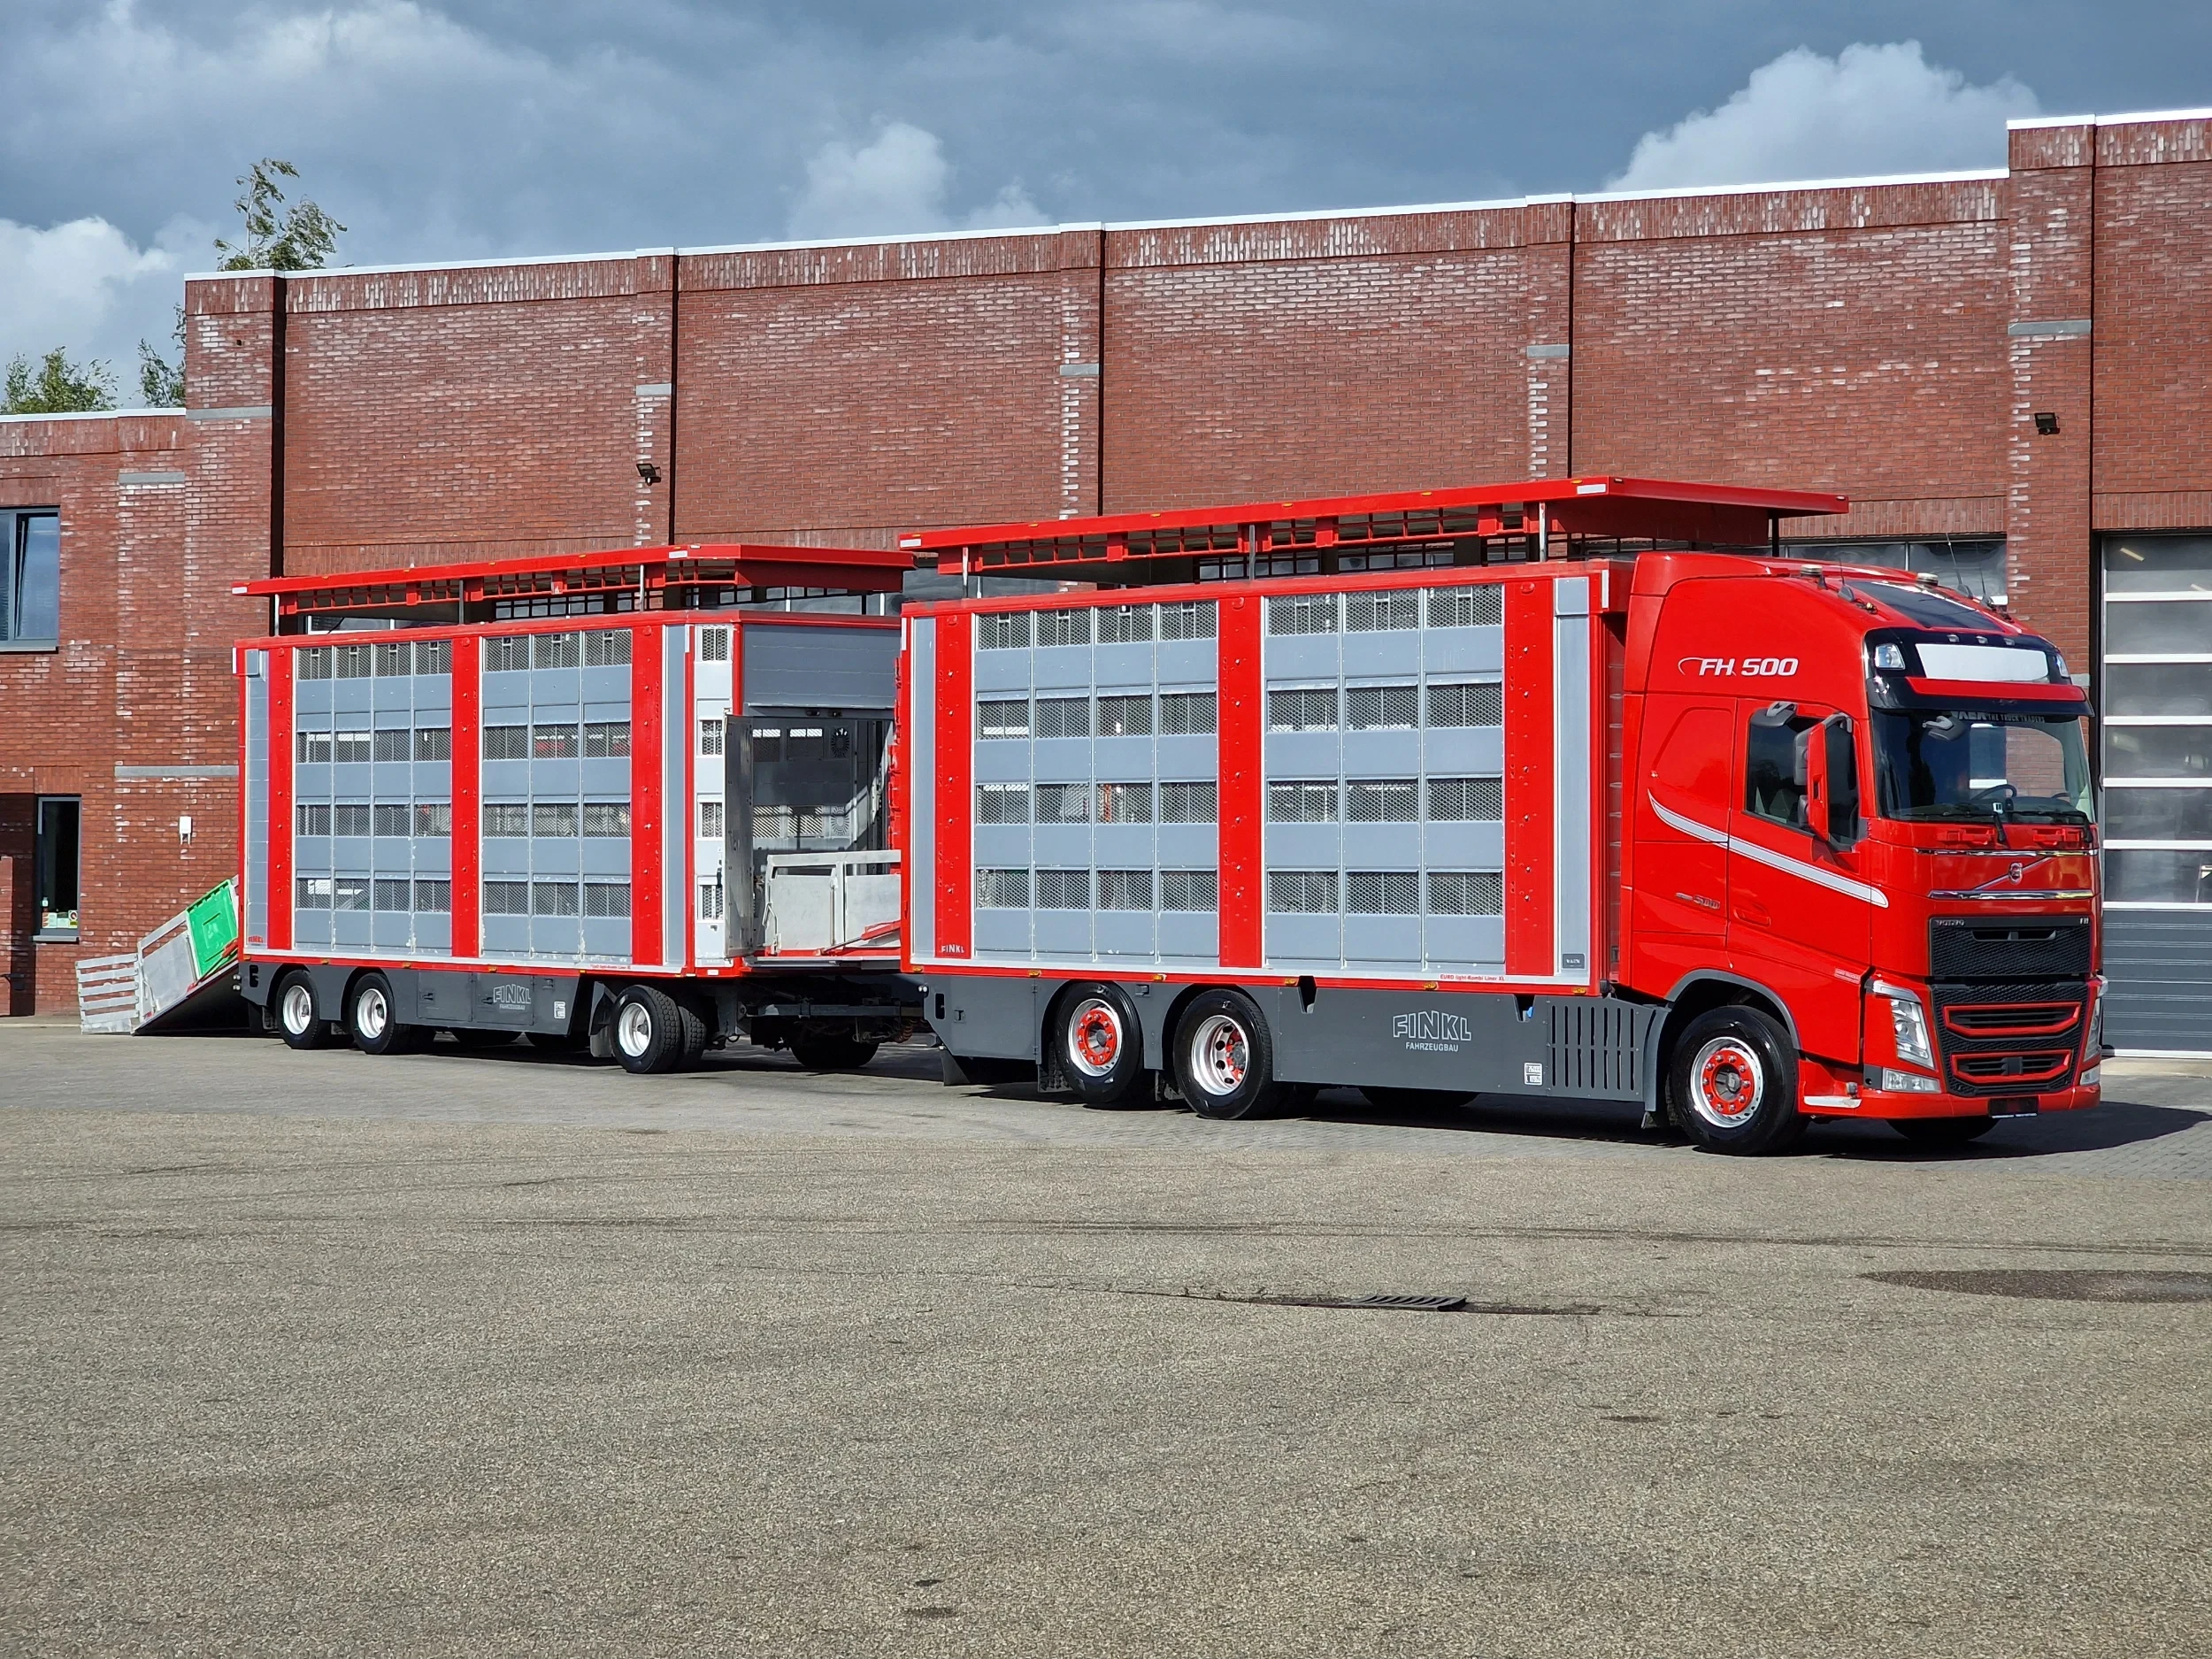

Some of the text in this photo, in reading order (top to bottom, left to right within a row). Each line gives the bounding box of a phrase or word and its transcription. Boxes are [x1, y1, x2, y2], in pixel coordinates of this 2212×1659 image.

[1699, 657, 1799, 676] FH 500
[941, 943, 965, 954] FINKL
[493, 983, 532, 1004] FINKL
[1393, 1010, 1472, 1041] FINKL
[1405, 1041, 1459, 1052] FAHRZEUGBAU
